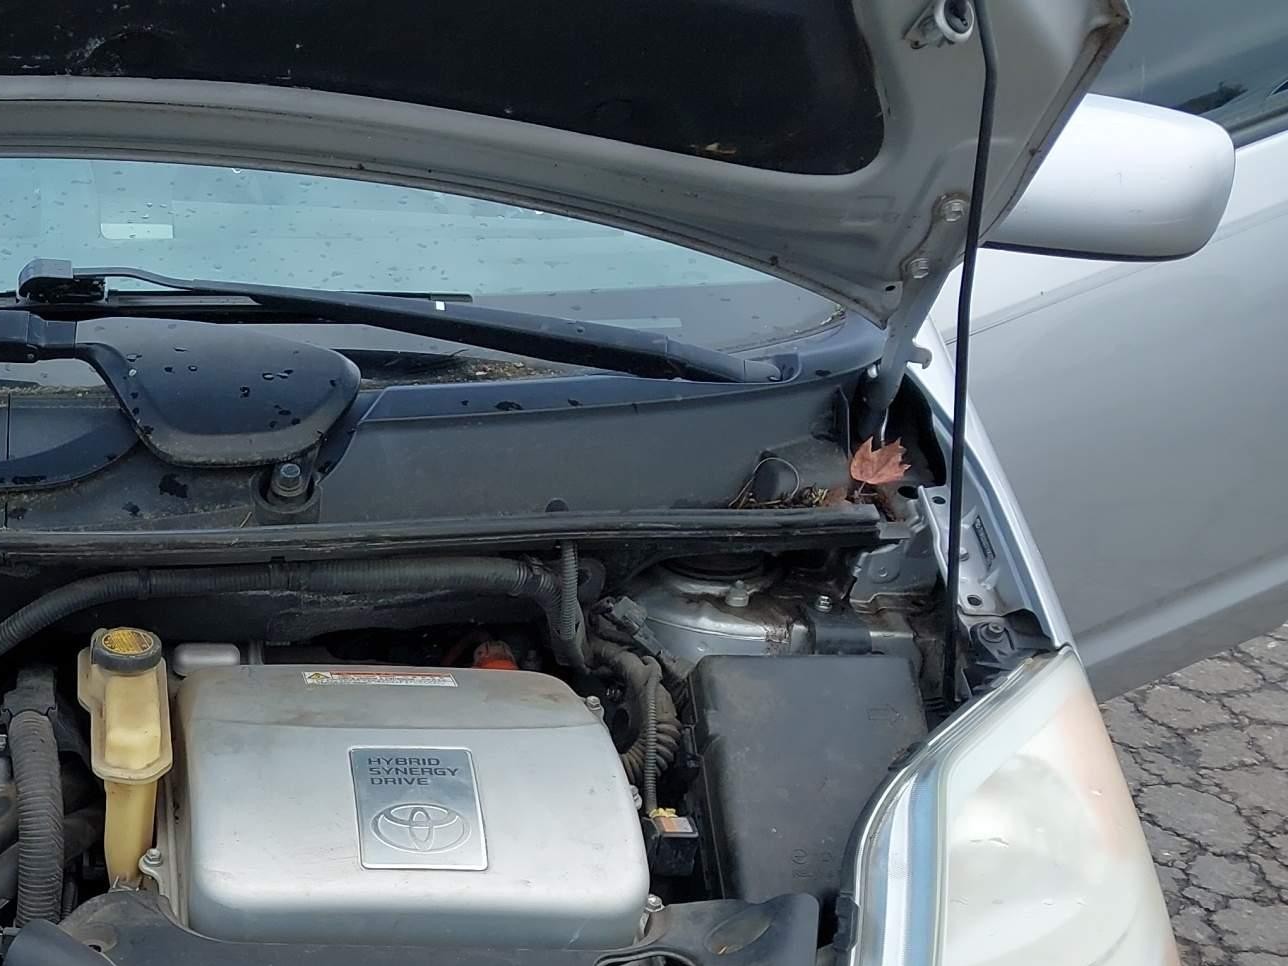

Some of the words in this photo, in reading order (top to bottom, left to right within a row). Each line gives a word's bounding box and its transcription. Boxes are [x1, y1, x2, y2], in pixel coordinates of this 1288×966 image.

[368, 757, 440, 766] HYBRID
[369, 767, 459, 776] SYNERGY
[371, 777, 429, 785] DRIVE
